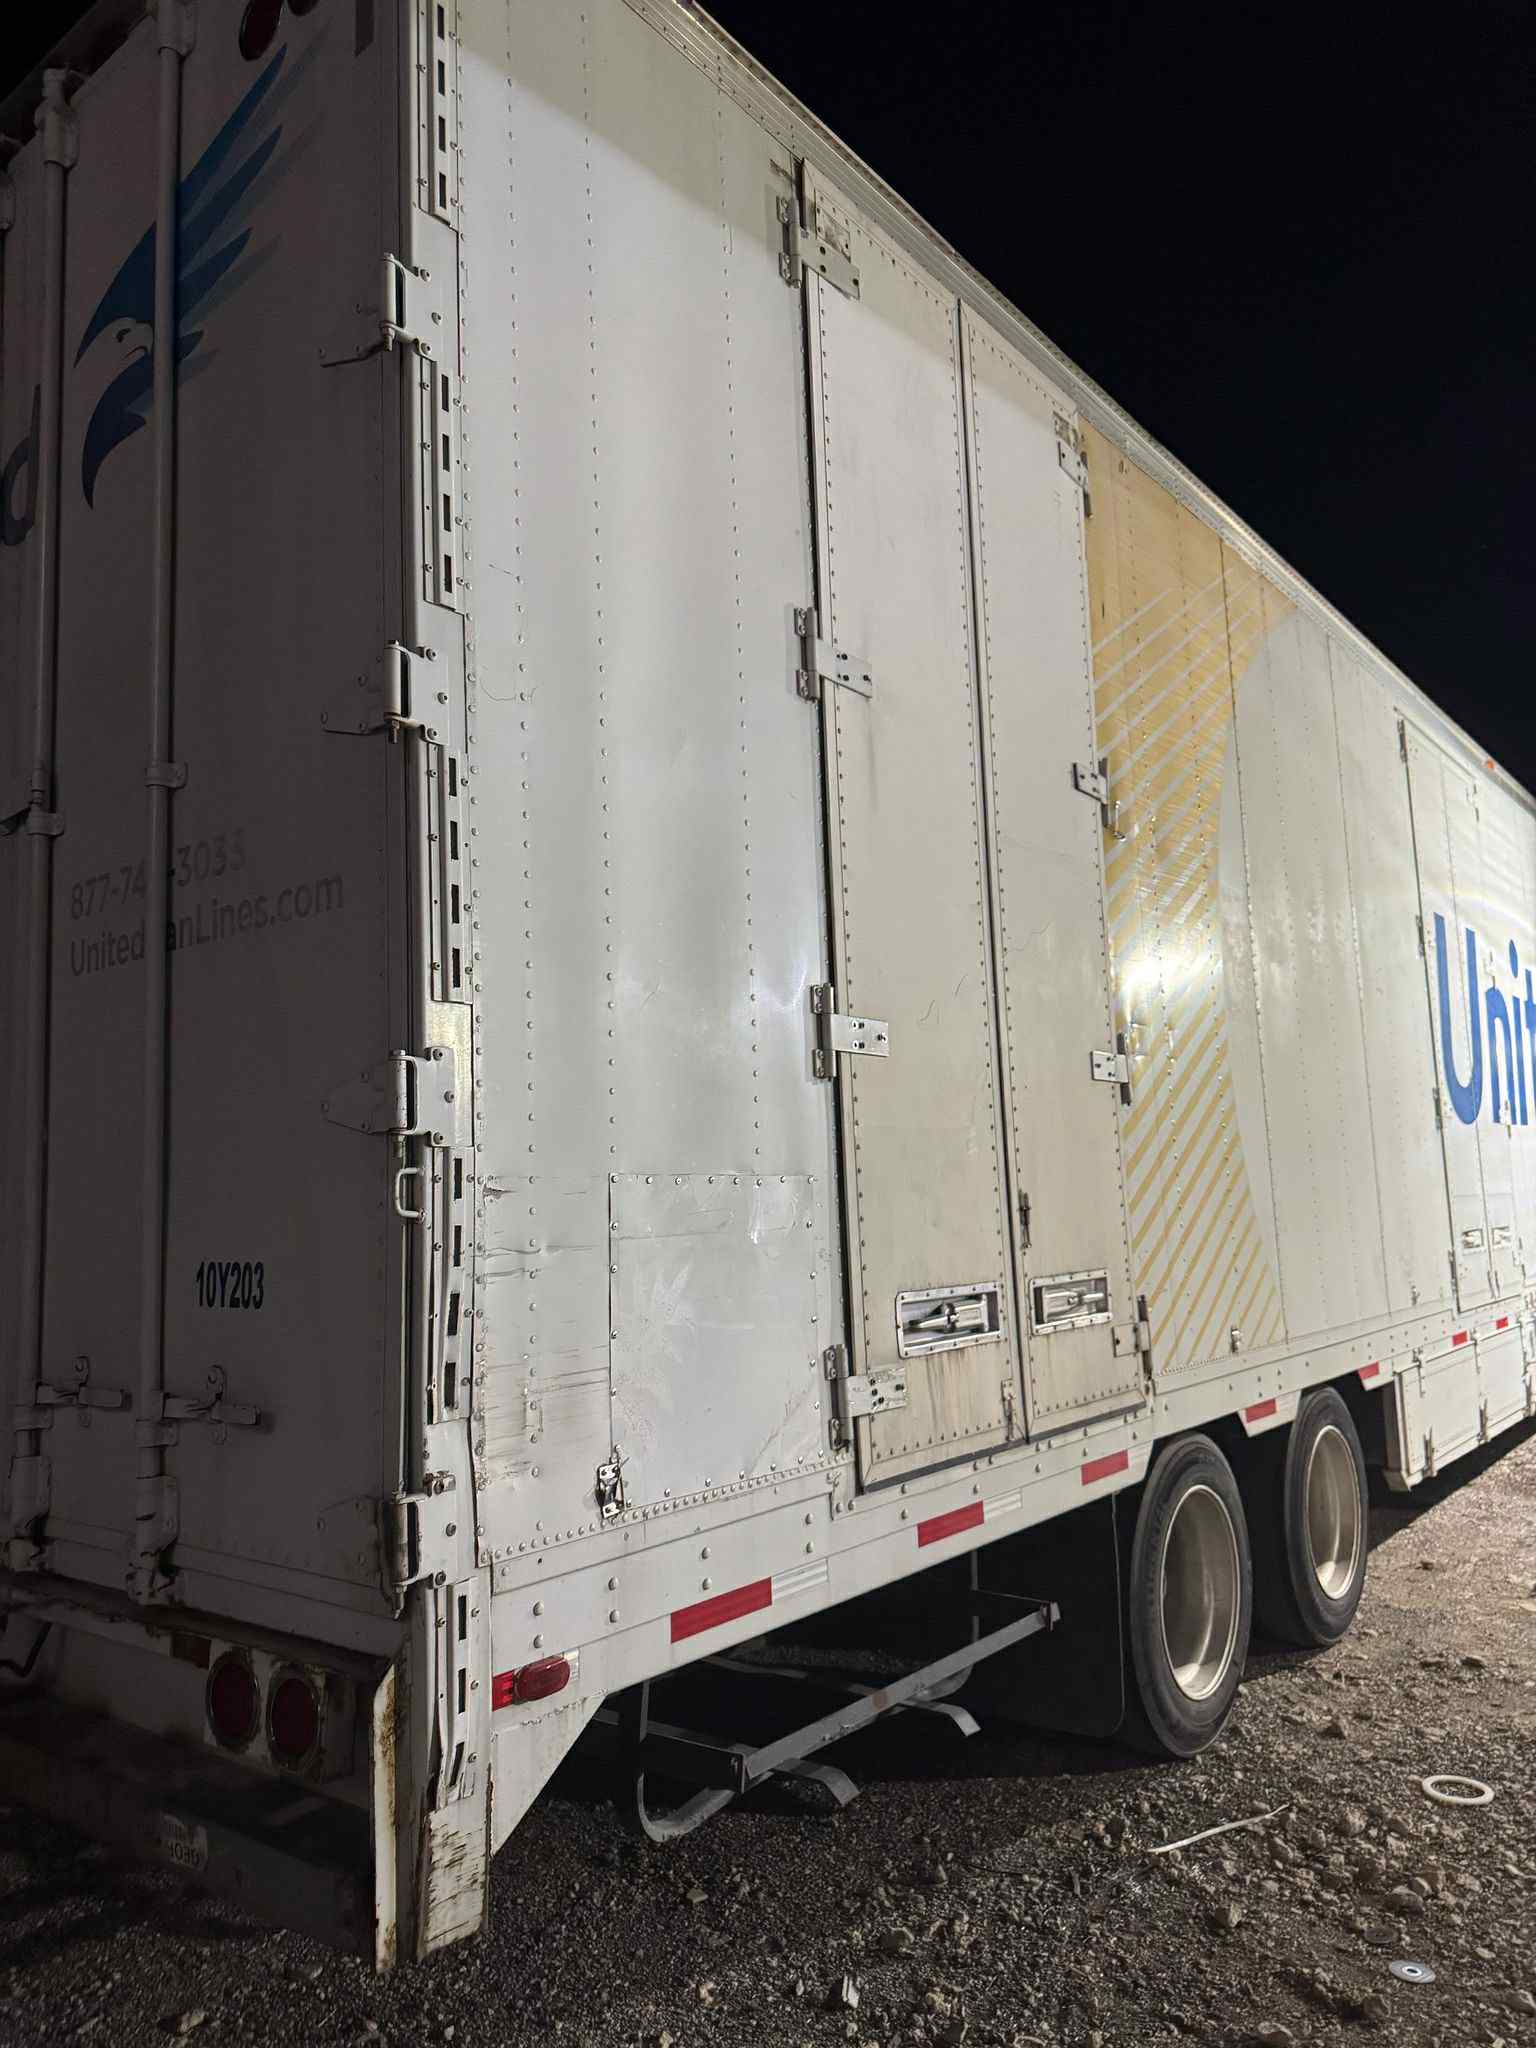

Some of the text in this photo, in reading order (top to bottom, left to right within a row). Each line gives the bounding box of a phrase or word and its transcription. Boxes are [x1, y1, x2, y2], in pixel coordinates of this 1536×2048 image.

[71, 826, 246, 920] 877-74-3033
[71, 872, 345, 977] UnitedanLines.com
[196, 1262, 264, 1309] 10Y203
